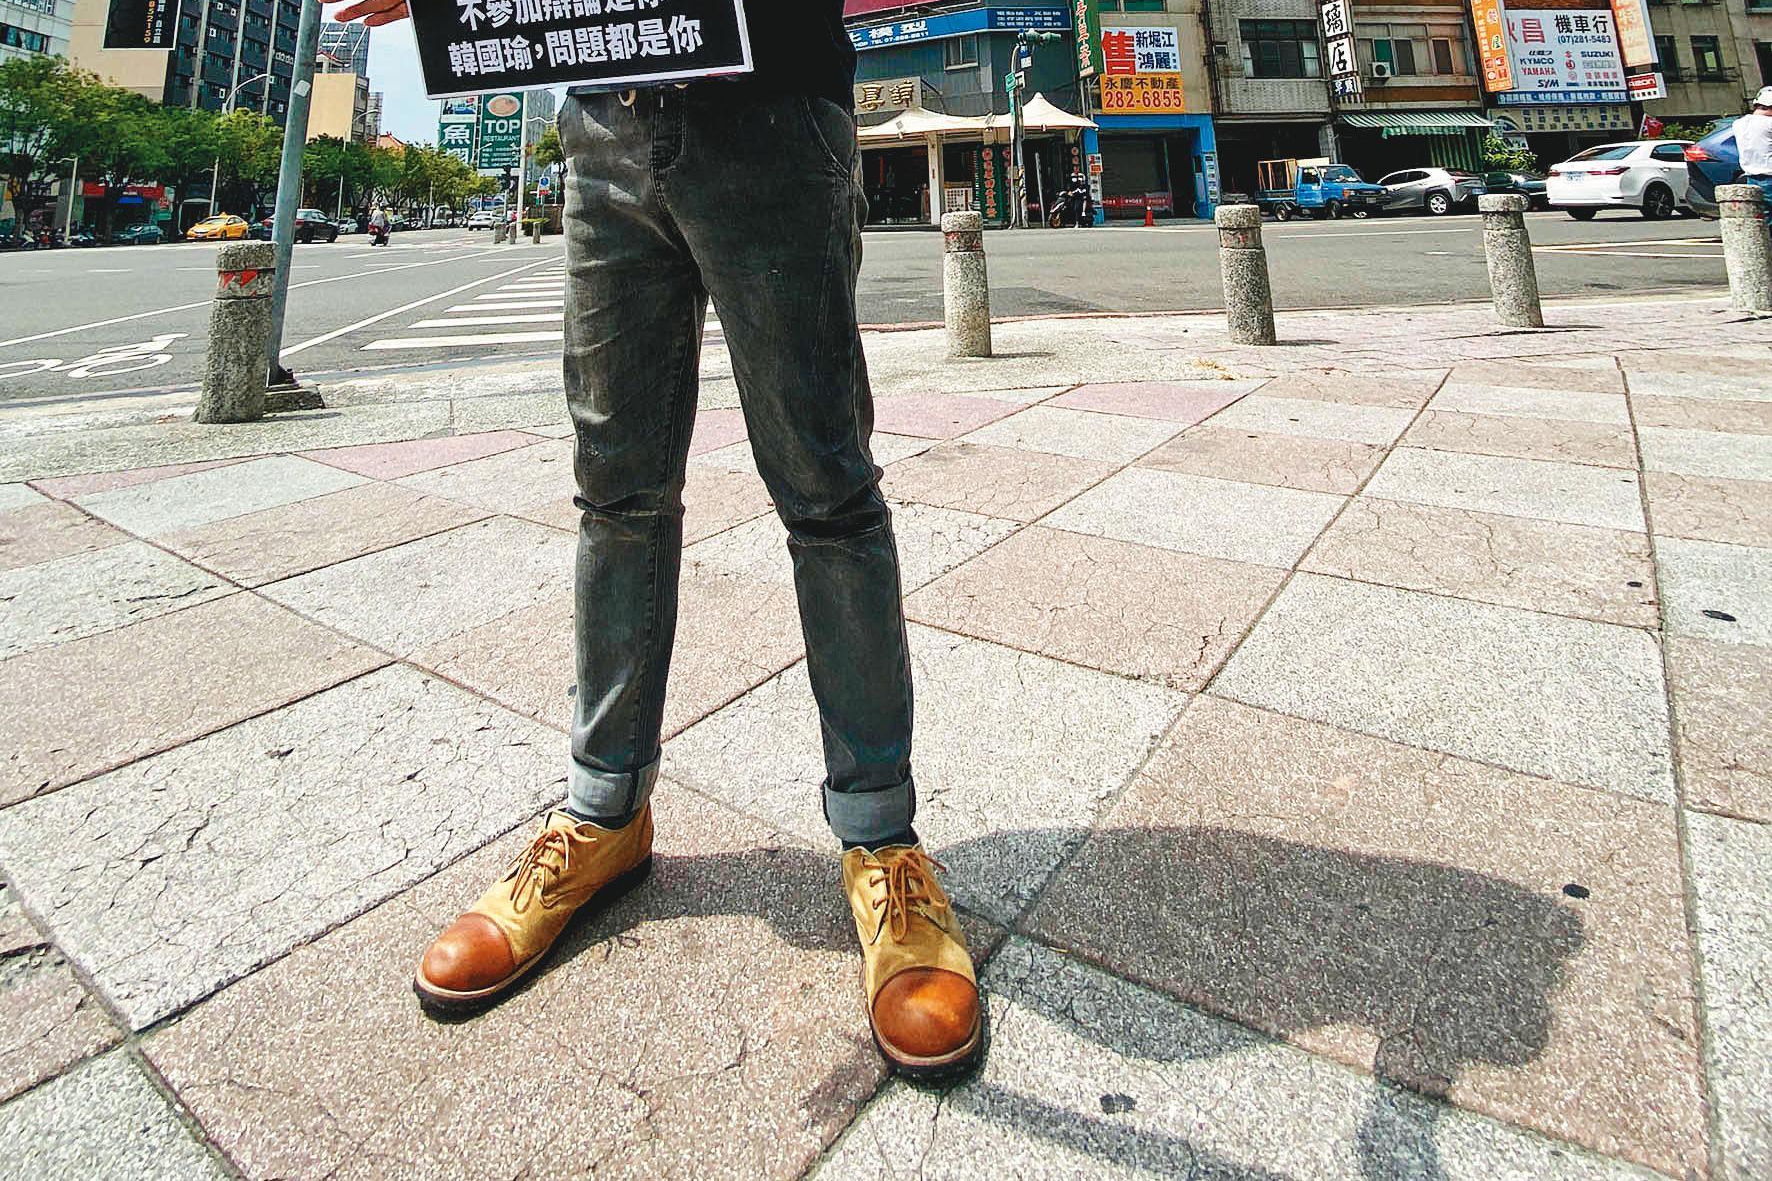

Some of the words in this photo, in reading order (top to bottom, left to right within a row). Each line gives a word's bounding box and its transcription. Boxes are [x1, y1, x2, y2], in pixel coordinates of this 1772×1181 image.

[1555, 14, 1609, 34] 機車行
[1136, 30, 1174, 49] 新堀江
[1101, 30, 1136, 76] 售
[1520, 57, 1555, 65] KYMCO
[1521, 67, 1557, 76] YAMAHA
[1105, 77, 1180, 89] 永慶不動產
[1537, 79, 1559, 88] SYM
[1105, 90, 1182, 108] 282-6855
[484, 119, 521, 134] TOP
